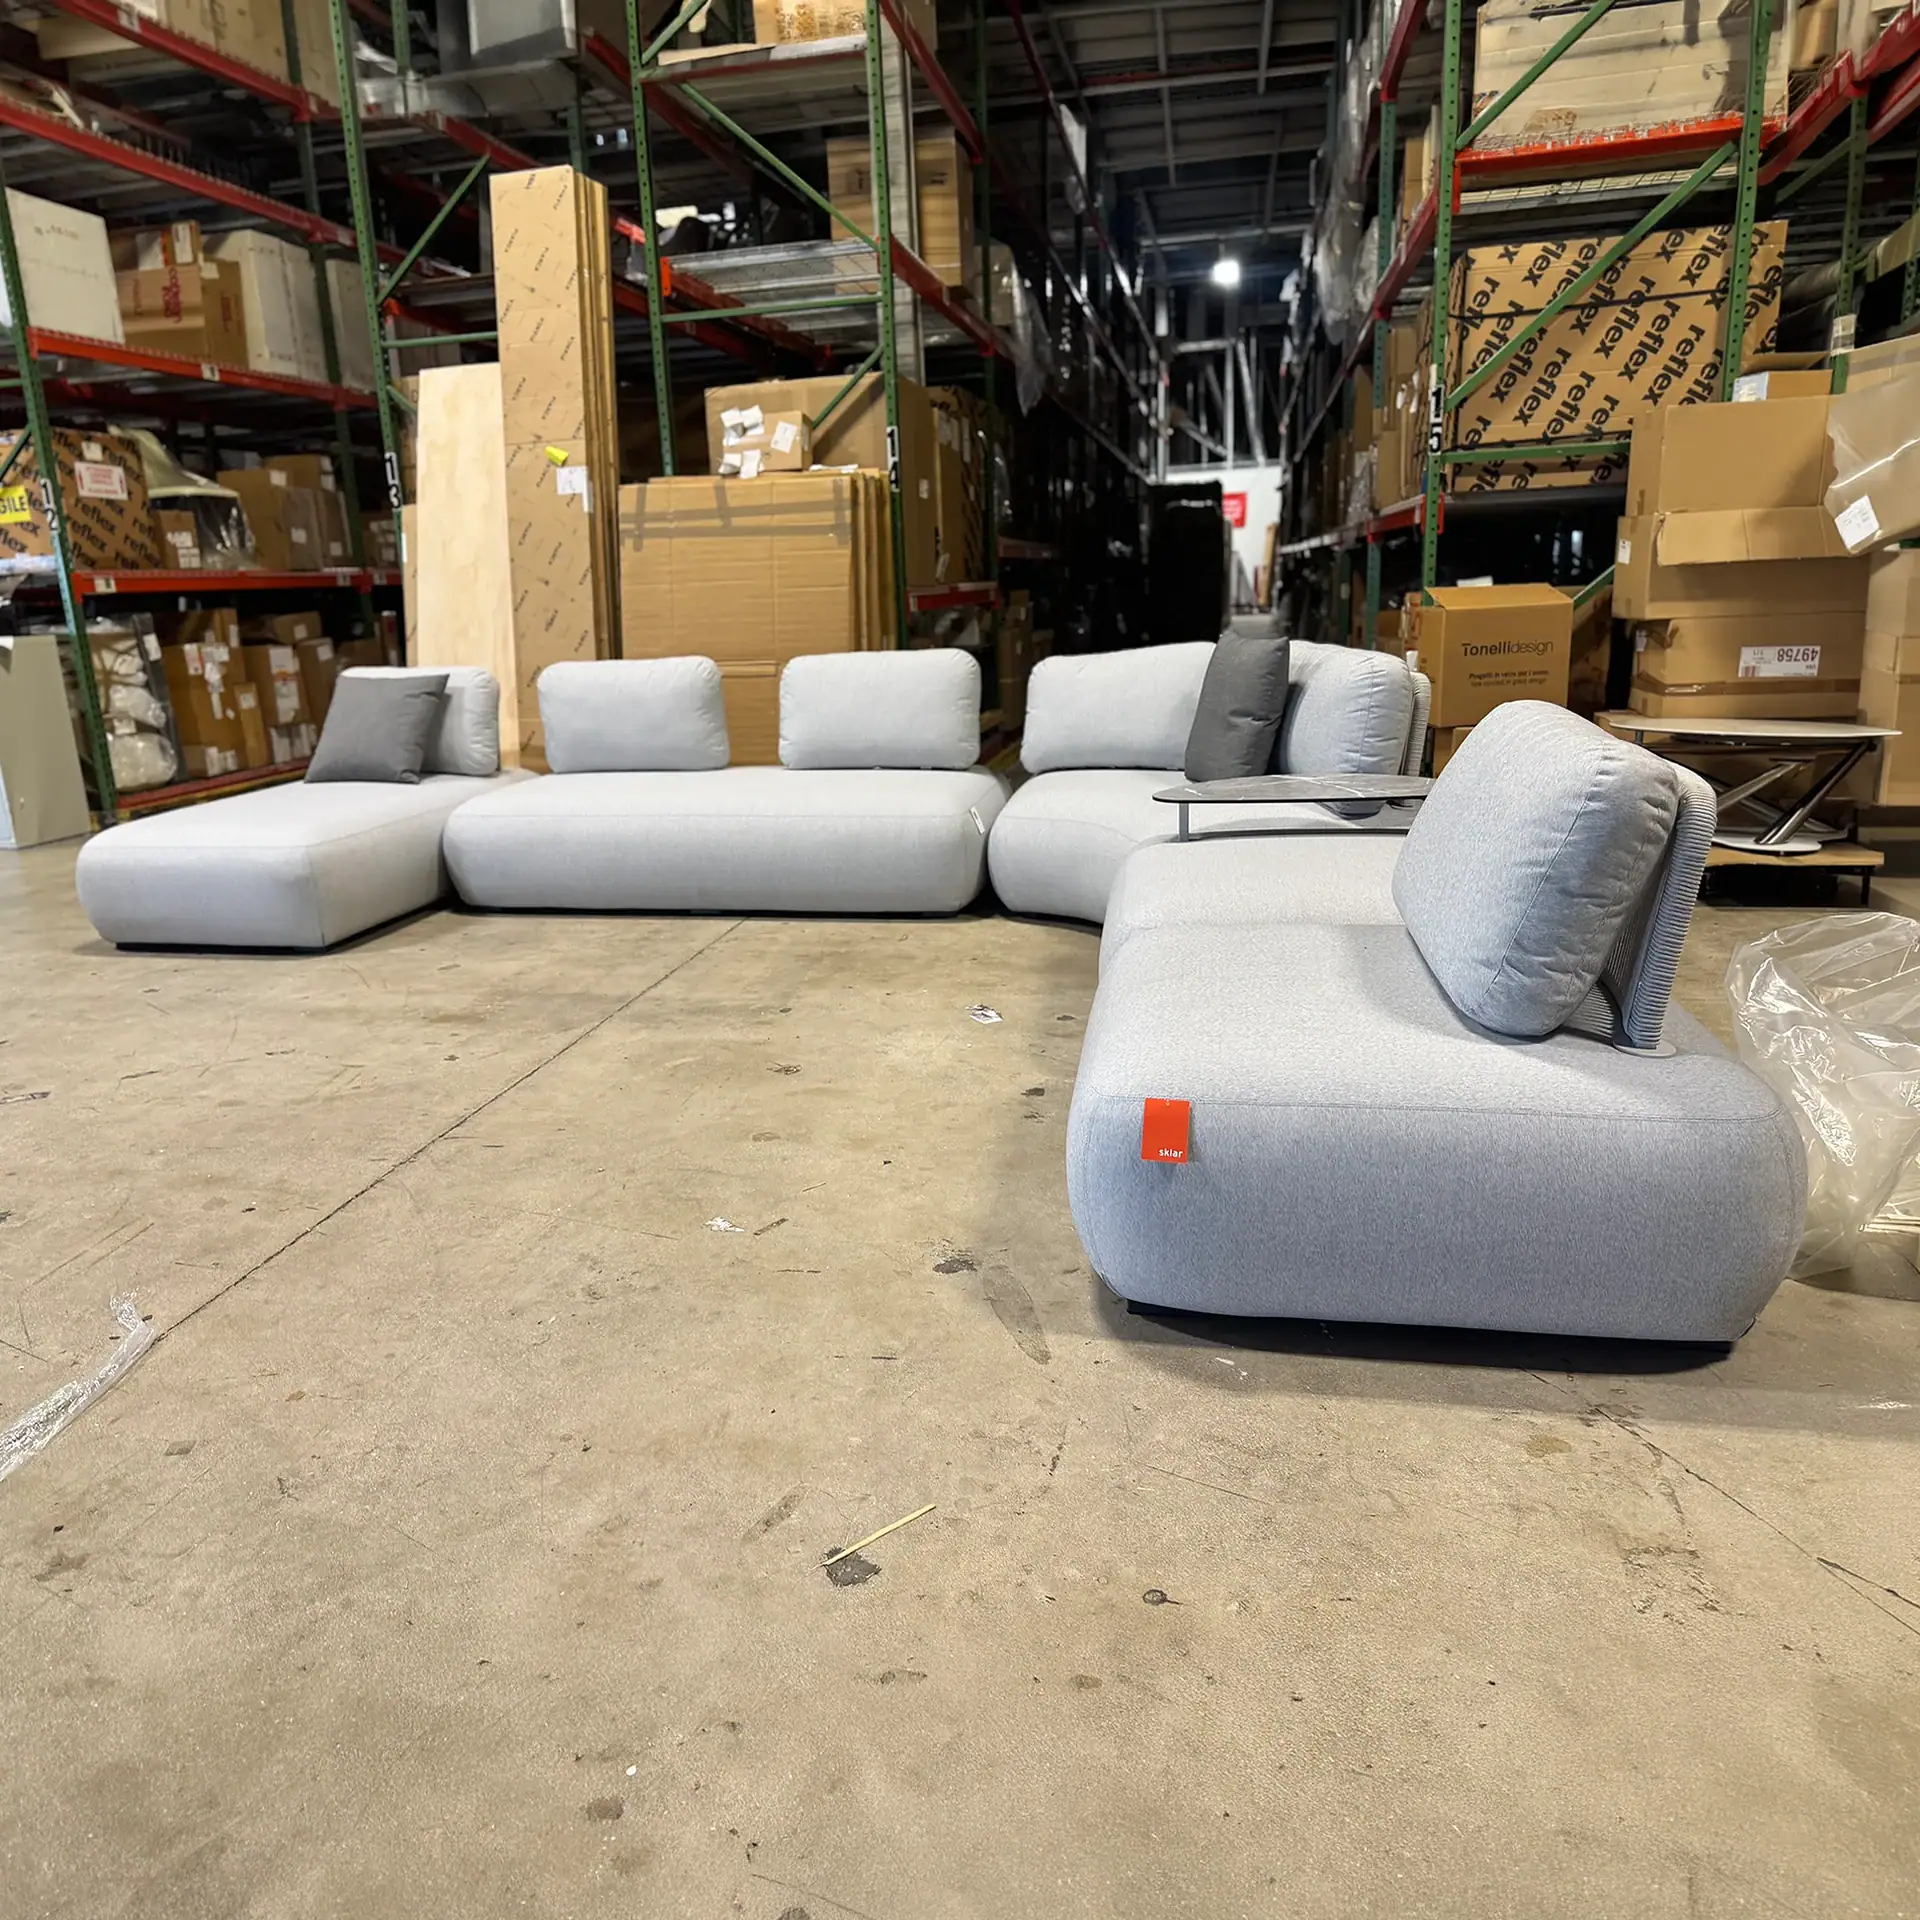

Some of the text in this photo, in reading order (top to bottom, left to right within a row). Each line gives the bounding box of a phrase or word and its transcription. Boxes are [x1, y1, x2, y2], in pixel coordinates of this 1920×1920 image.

[1593, 276, 1656, 360] reflex
[1617, 300, 1681, 383] reflex
[1512, 347, 1573, 427] reflex
[1642, 324, 1706, 407] reflex
[1777, 647, 1818, 662] 49758
[1158, 1148, 1184, 1158] sklar
